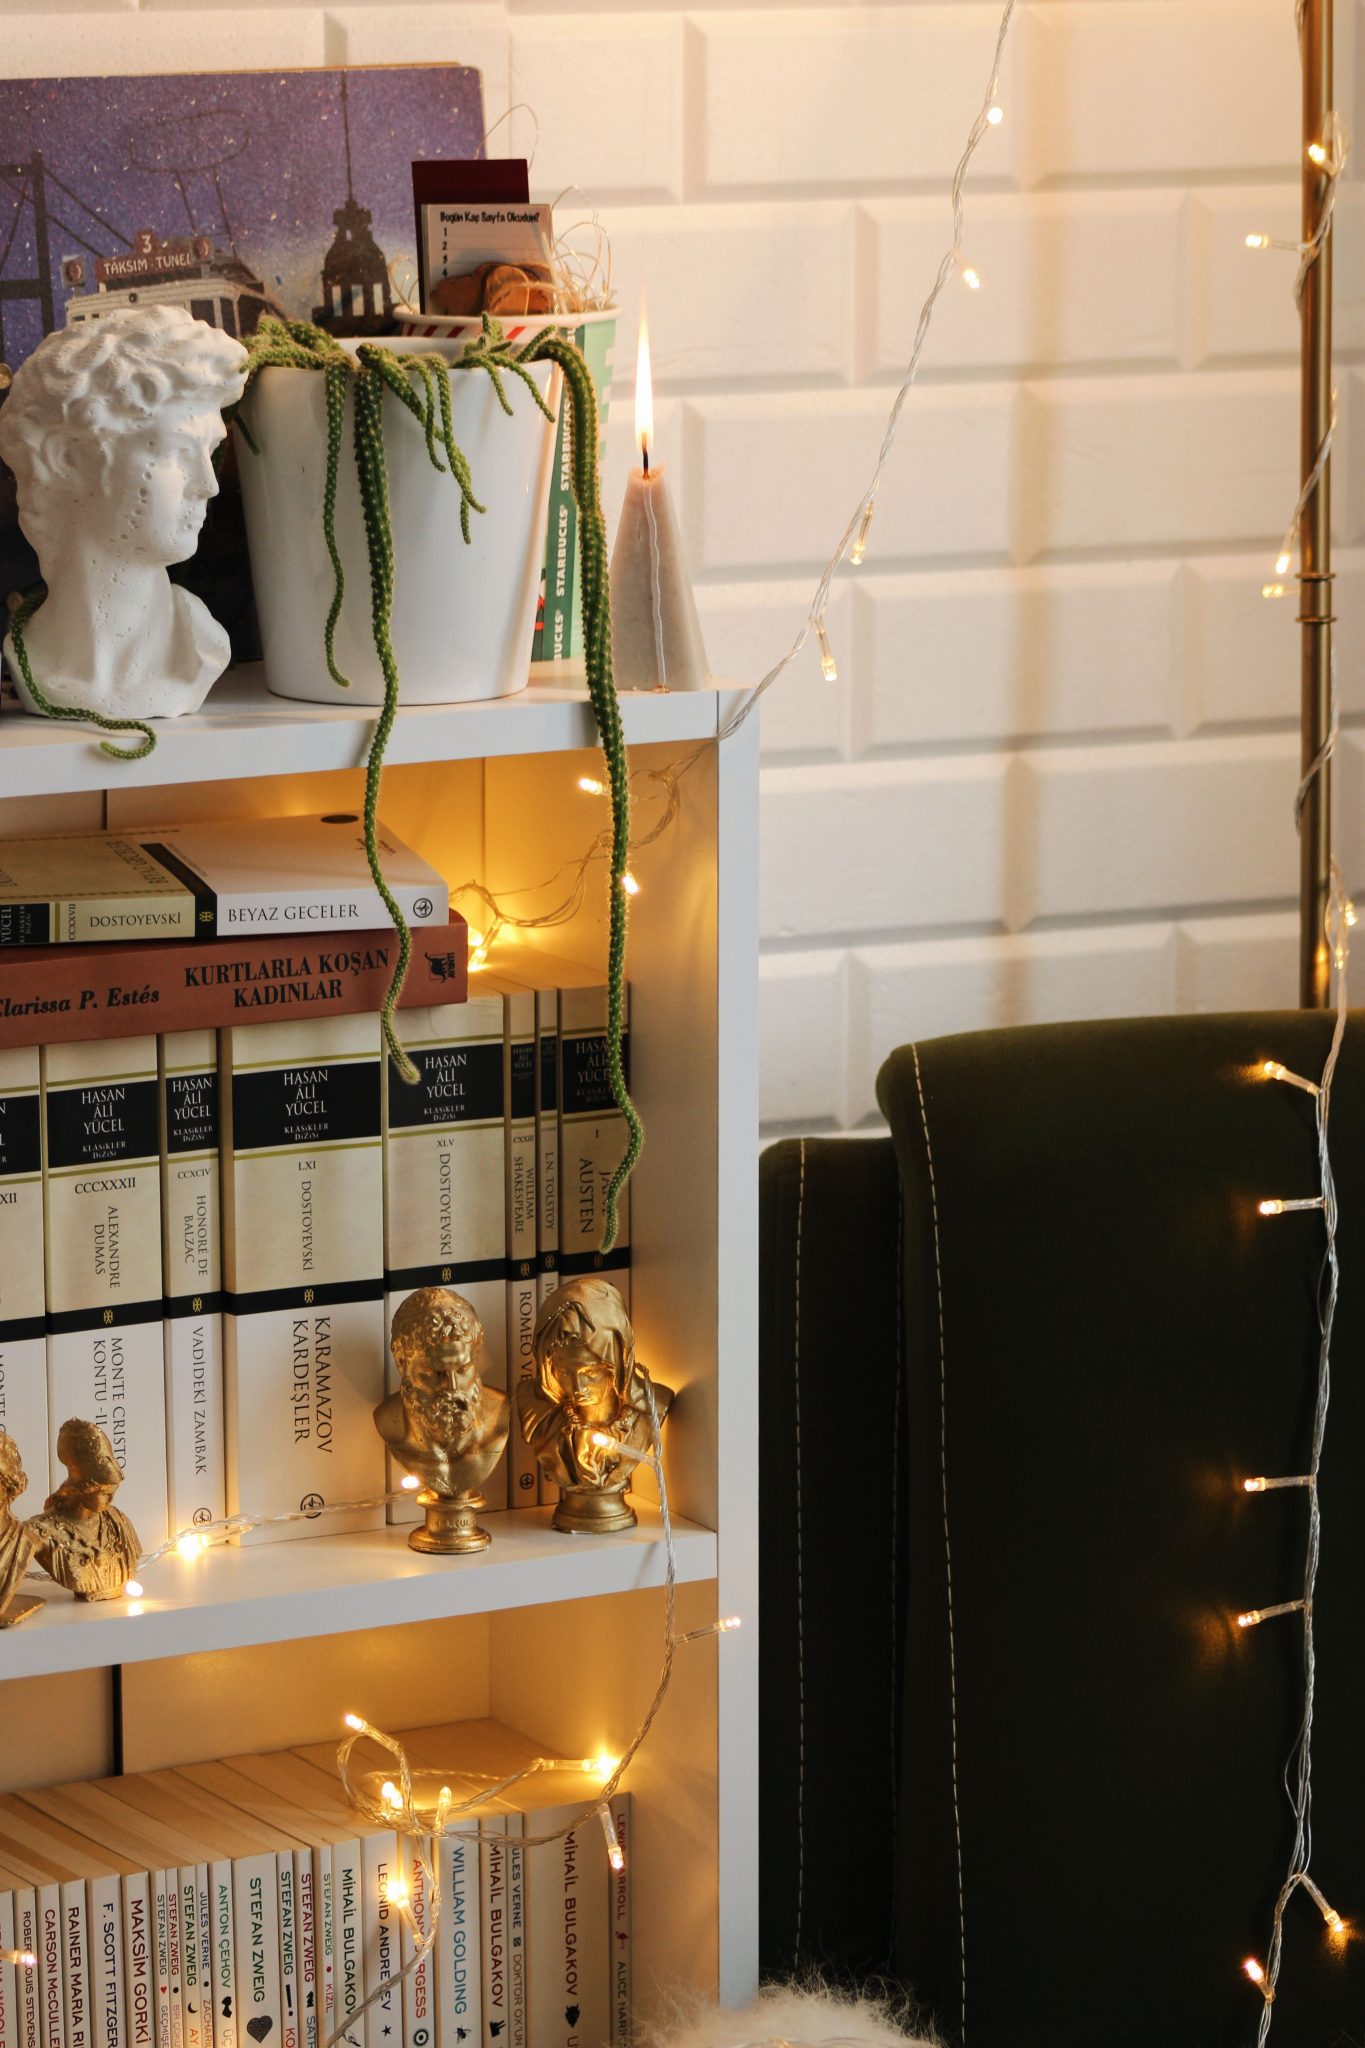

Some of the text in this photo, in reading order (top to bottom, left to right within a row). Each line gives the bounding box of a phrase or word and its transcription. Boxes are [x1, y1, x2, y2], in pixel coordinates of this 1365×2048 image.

[440, 211, 540, 224] Bugün Kaç Sayfa Okudum?
[443, 227, 447, 237] 1
[103, 258, 148, 276] TAKSIM
[141, 234, 153, 253] 3
[442, 241, 448, 250] 2
[442, 255, 448, 264] 3
[556, 507, 569, 597] STARBUCKS
[89, 911, 181, 928] DOSTOYEVSKİ
[228, 904, 360, 923] BEYAZ GECELER
[184, 949, 390, 988] KURTLARLA KOŞAN
[78, 990, 98, 1010] P.
[106, 985, 161, 1008] Estés
[233, 979, 344, 1009] KADINLAR
[425, 1053, 468, 1070] HASAN
[576, 1041, 609, 1055] HASA
[81, 1088, 126, 1105] HASAN
[172, 1077, 213, 1093] HASAN
[283, 1069, 328, 1087] HASAN
[426, 1083, 466, 1099] YÜCEL
[83, 1118, 125, 1135] YÜCEL
[174, 1105, 212, 1120] YÜCEL
[285, 1100, 328, 1117] YÜCEL
[298, 1160, 317, 1171] LXI
[436, 1138, 455, 1148] XLV
[74, 1177, 136, 1195] CCCXXXII
[177, 1168, 211, 1180] CCXCIV
[514, 1156, 524, 1234] SHAKESPEARE
[525, 1168, 535, 1220] WILLIAM
[579, 1158, 594, 1233] AUSTEN
[301, 1180, 315, 1272] DOSTOYEVSKİ
[439, 1152, 453, 1257] DOSTOYEVSKİ
[545, 1176, 555, 1231] TOLSTOY
[94, 1224, 106, 1276] DUMAS
[108, 1205, 121, 1289] ALEXANDRE
[184, 1215, 195, 1264] BALZAC
[196, 1195, 208, 1276] HONORÉ DE
[519, 1291, 533, 1383] ROMEO VE
[93, 1339, 108, 1401] KONTU
[290, 1319, 310, 1445] KARDEŞLER
[315, 1317, 333, 1454] KARAMAZOV
[111, 1337, 127, 1470] MONTE CRISTO
[192, 1326, 208, 1476] VADİDEKİ ZAMBAK
[157, 1894, 166, 1939] STEFAN
[168, 1894, 177, 1938] STEFAN
[200, 1892, 209, 1928] JULES
[281, 1871, 291, 1928] STEFAN
[301, 1873, 313, 1933] STEFAN
[617, 1867, 627, 1920] ARROLL
[250, 1877, 265, 2003] STEFAN ZWEIG
[323, 1873, 334, 2014] STEFAN ZWEIG KIZIL
[342, 1868, 356, 2015] MİHAİL BULGAKOV
[377, 1863, 391, 2011] LEONİD ANDREEV
[413, 1859, 427, 2019] ANTHONY RGESS
[452, 1846, 467, 2015] WILLIAM GOLDING
[490, 1844, 504, 2007] MİHAİL BULGAKOV
[512, 1847, 523, 2047] ULES VERNE DOKTOR OX'UN
[564, 1831, 579, 2048] MİHAİL BULGAKOV U
[103, 1902, 118, 2048] F. SCOTT FITZGER
[131, 1899, 152, 2044] MAKSİM GORKİ
[158, 1941, 168, 1976] ZWEIG
[170, 1941, 179, 1976] ZWEIG
[183, 1885, 200, 2045] STEFAN ZWEIG AY
[201, 1931, 210, 1970] VERNE
[218, 1884, 233, 2047] ANTON ÇEHOV ÜÇ
[282, 1931, 294, 1976] ZWEIG
[303, 1935, 315, 1983] ZWEIG
[24, 1965, 34, 1992] OUIS
[44, 1909, 61, 2048] CARSON McCULLE
[68, 1906, 85, 2048] RAINER MARIA RI
[617, 1961, 627, 1999] ALICE
